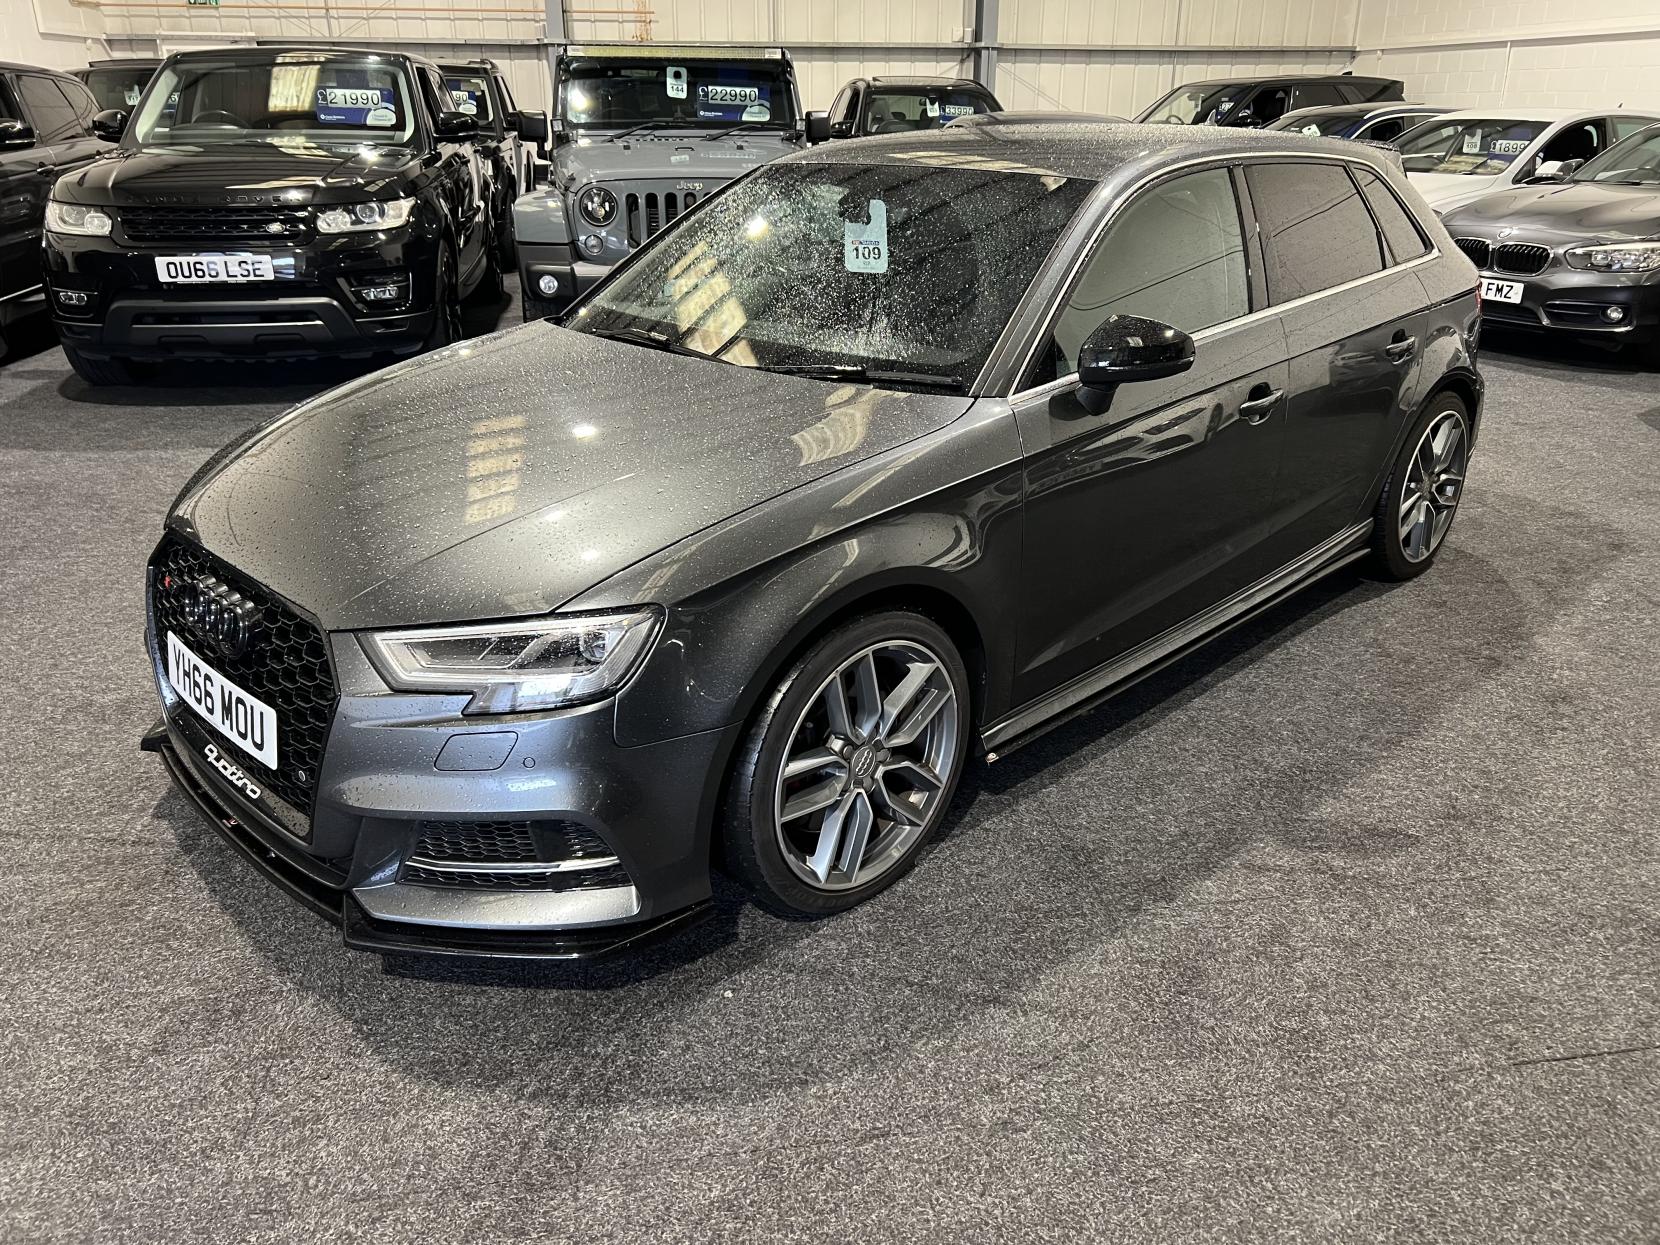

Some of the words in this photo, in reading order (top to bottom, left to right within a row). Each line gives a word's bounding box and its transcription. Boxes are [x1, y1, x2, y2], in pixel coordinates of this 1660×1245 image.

[670, 85, 684, 93] 144
[676, 180, 704, 190] Jeep
[852, 245, 882, 260] 109
[166, 261, 219, 279] OU66
[224, 260, 265, 278] LSE
[1485, 282, 1514, 299] FMZ
[173, 643, 215, 716] YH66
[220, 684, 265, 752] MOU
[204, 743, 262, 799] quattro
